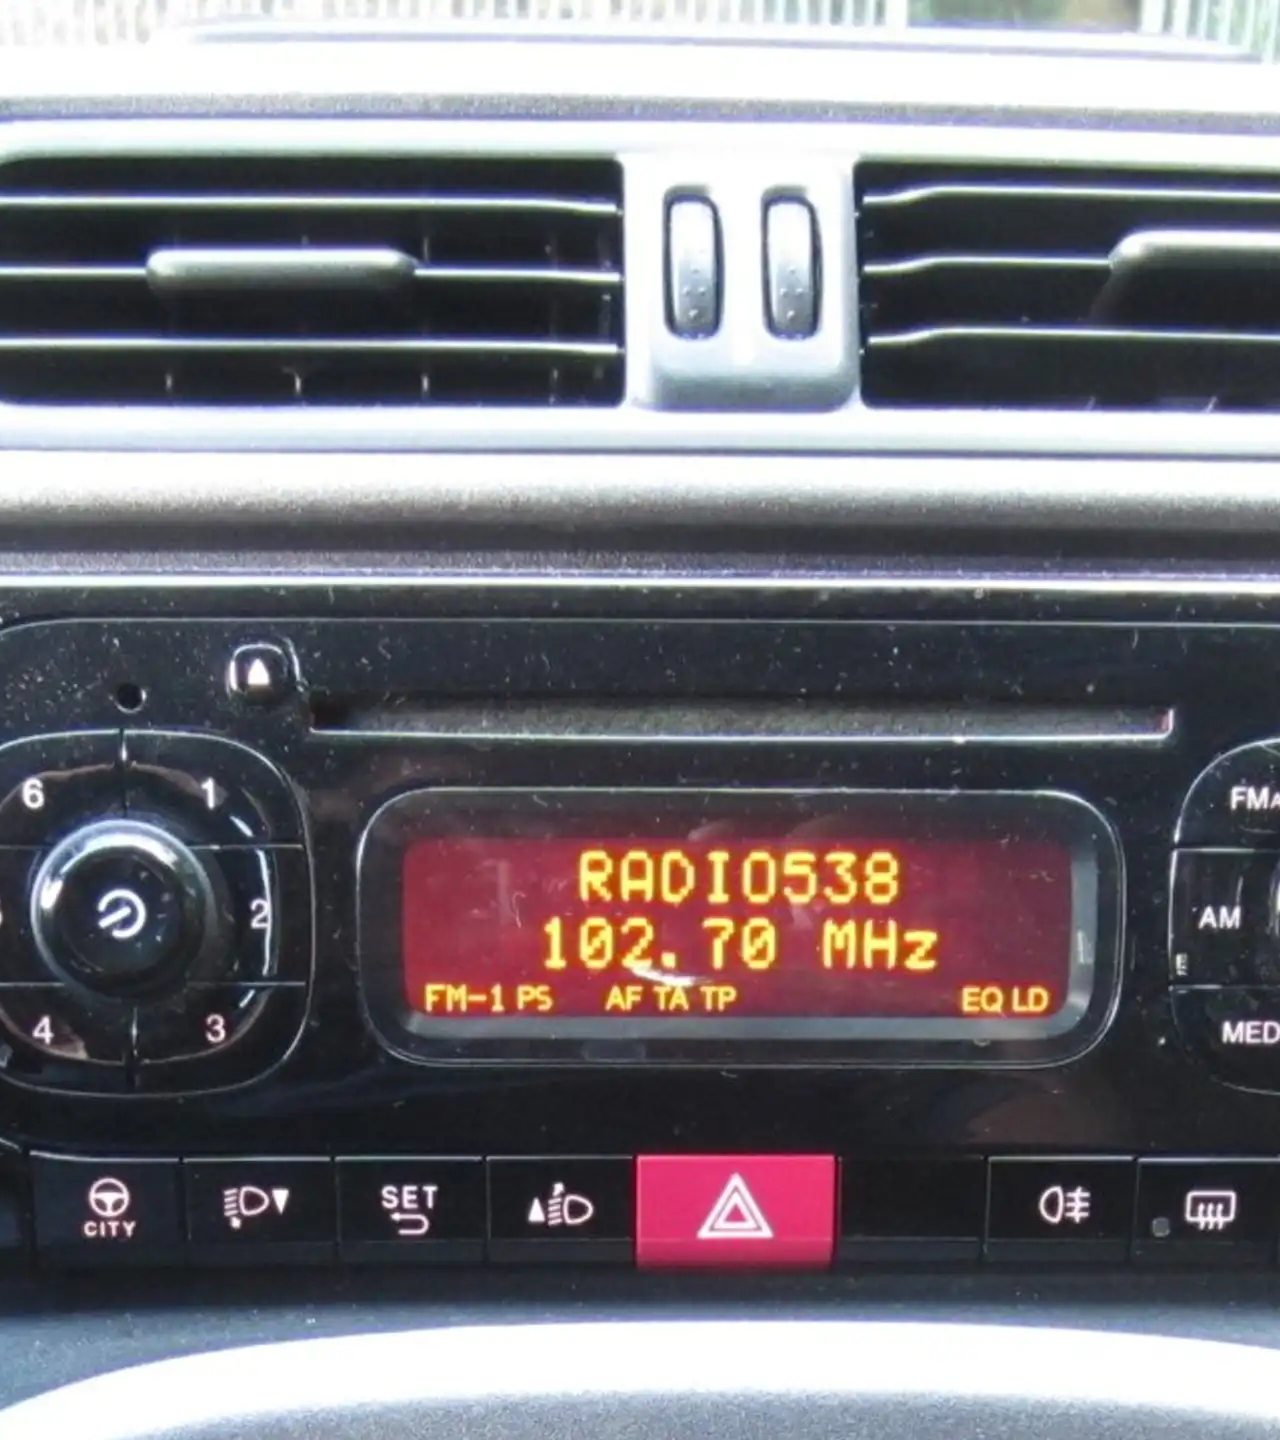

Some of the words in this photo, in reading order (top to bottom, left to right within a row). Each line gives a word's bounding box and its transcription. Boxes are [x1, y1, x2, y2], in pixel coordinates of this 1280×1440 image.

[22, 778, 44, 809] 6
[200, 778, 216, 809] 1
[579, 850, 901, 905] RADIO538
[249, 898, 271, 928] 2
[1198, 906, 1241, 929] AM
[543, 916, 778, 970] 102.70
[822, 917, 939, 970] MHz
[424, 984, 505, 1012] FM-1
[516, 985, 553, 1012] PS
[605, 985, 642, 1012] AF
[653, 985, 690, 1012] TA
[700, 985, 738, 1012] TP
[962, 987, 1004, 1013] EQ
[1012, 987, 1050, 1013] LD
[32, 1015, 54, 1045] 4
[205, 1014, 227, 1043] 3
[381, 1185, 438, 1210] SET
[83, 1221, 137, 1238] CITY
